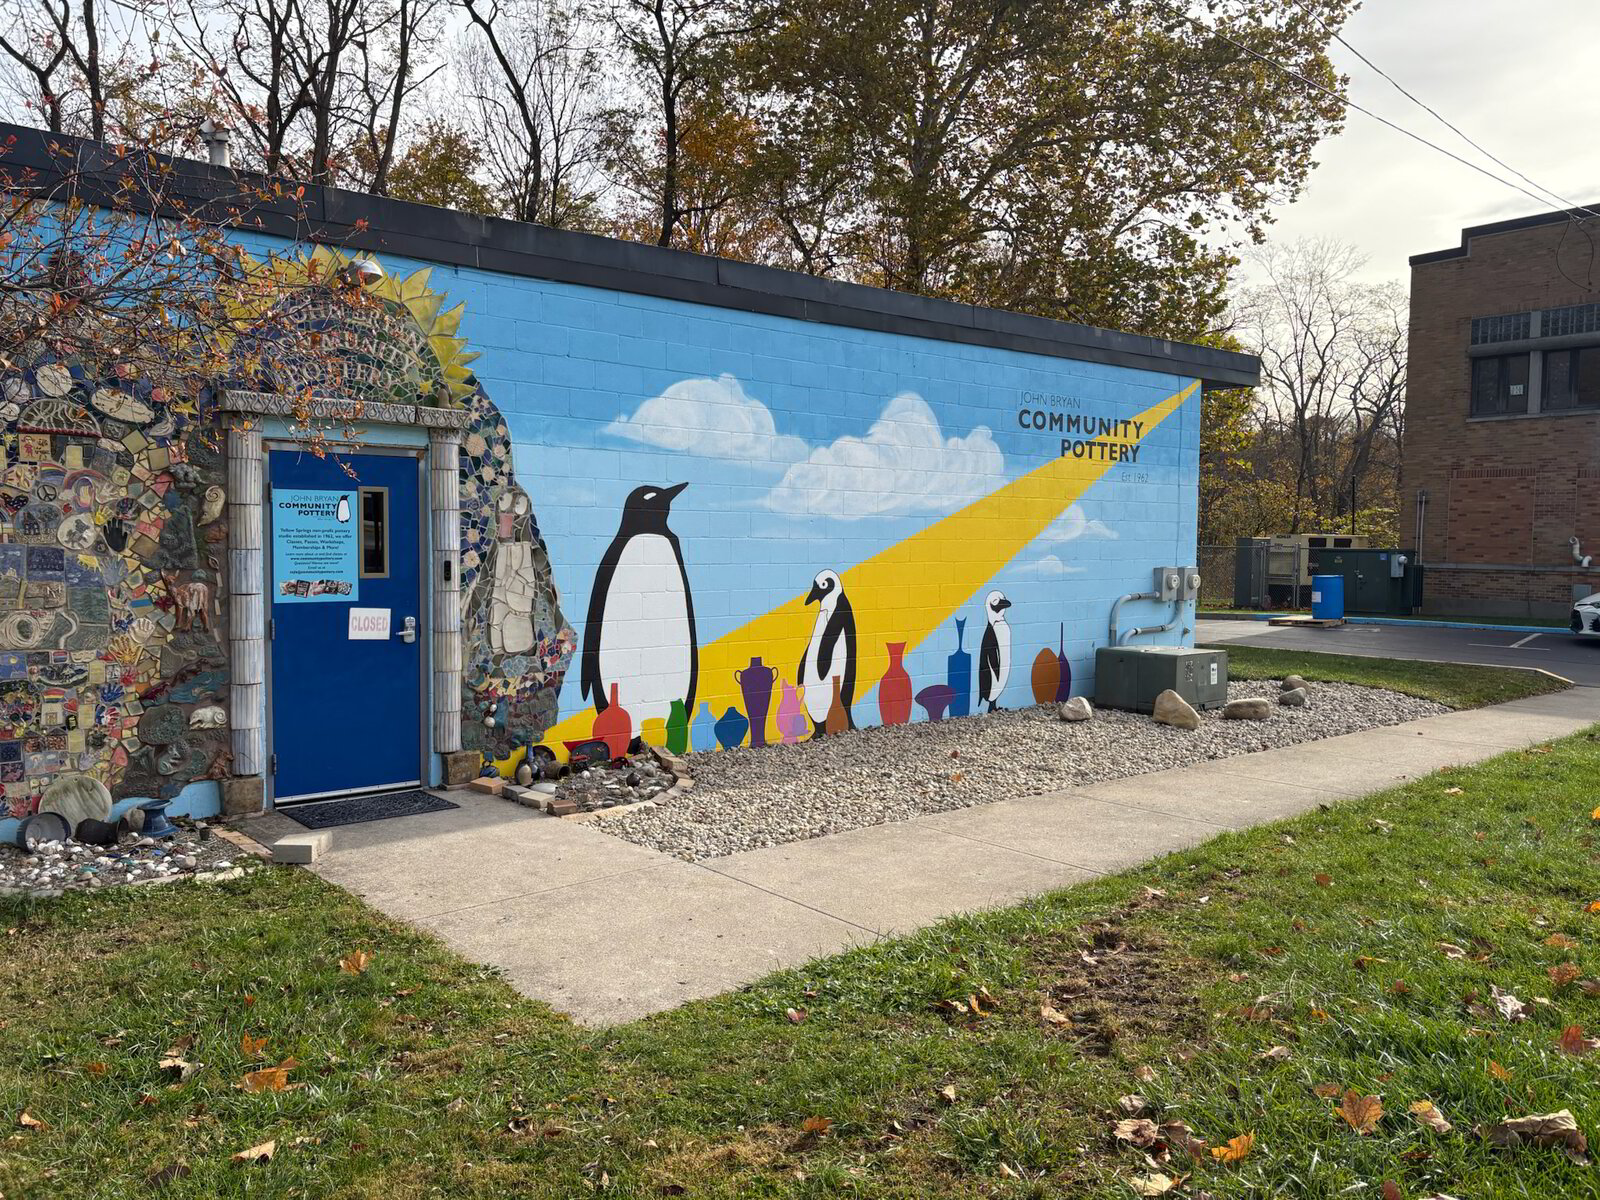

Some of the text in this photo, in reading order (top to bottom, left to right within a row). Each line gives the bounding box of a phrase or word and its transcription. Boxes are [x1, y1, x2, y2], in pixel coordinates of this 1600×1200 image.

[1019, 391, 1081, 409] JOHN BRYAN
[1018, 409, 1144, 439] COMMUNITY
[1060, 439, 1141, 463] POTTERY
[352, 616, 388, 631] CLOSED
